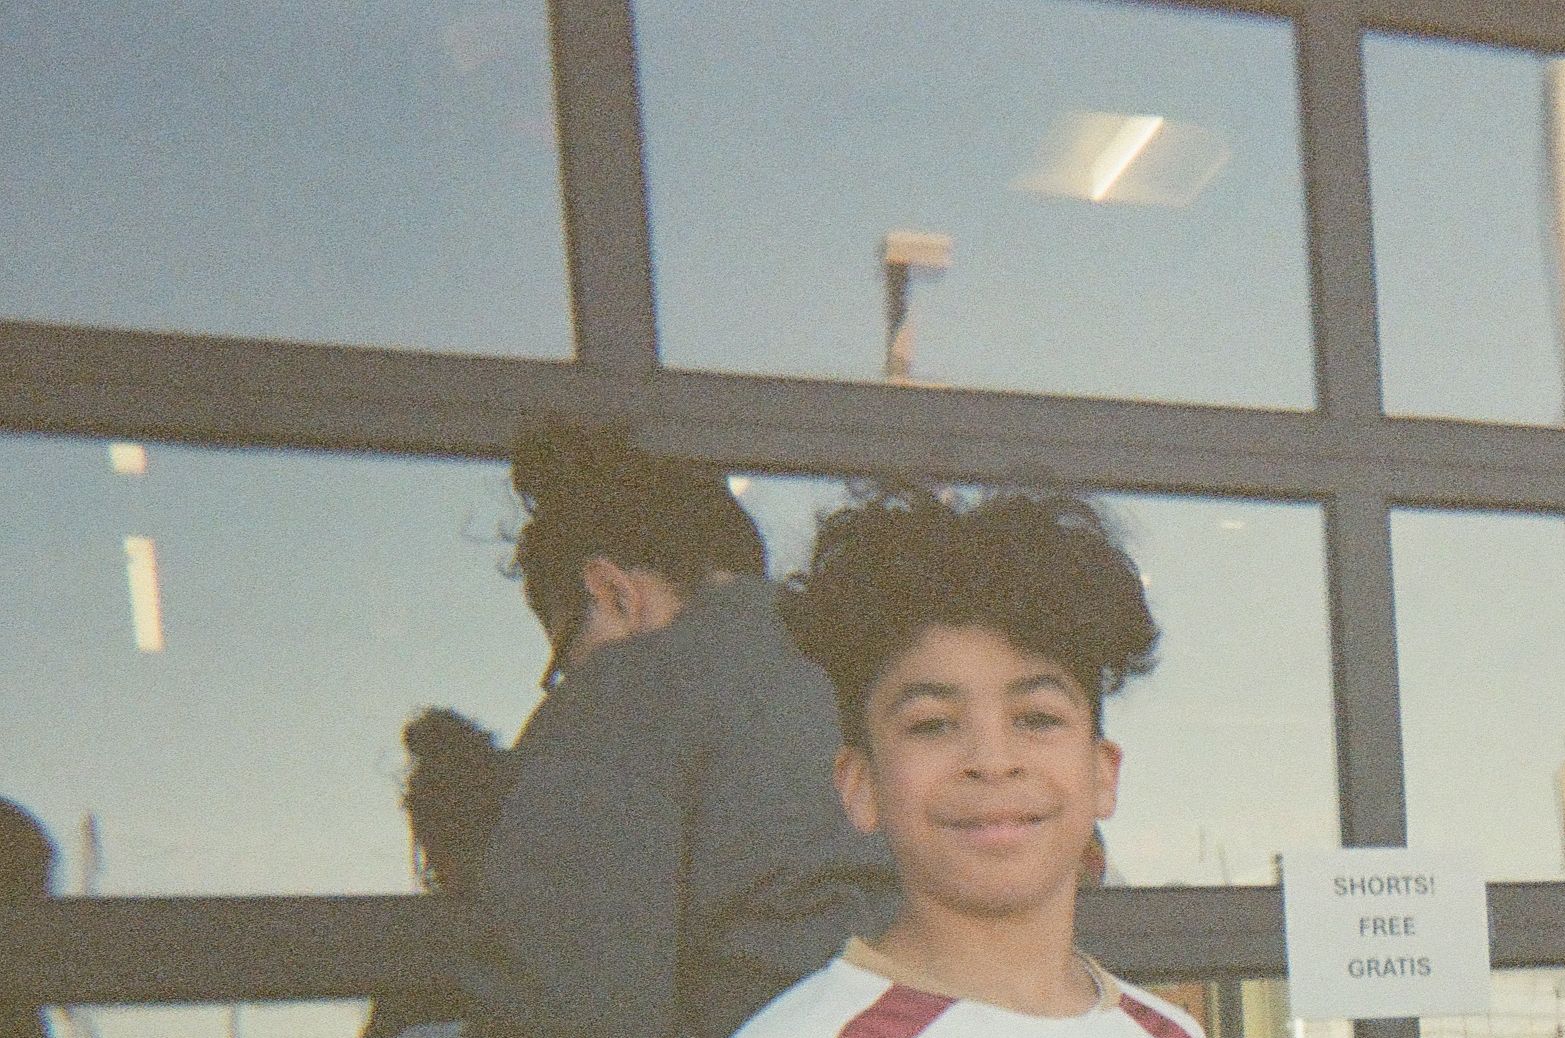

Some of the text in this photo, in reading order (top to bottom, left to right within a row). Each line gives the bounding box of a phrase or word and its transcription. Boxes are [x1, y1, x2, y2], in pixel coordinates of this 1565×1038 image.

[1333, 875, 1435, 896] SHORTS!
[1359, 916, 1416, 937] FREE
[1348, 957, 1432, 979] GRATIS
